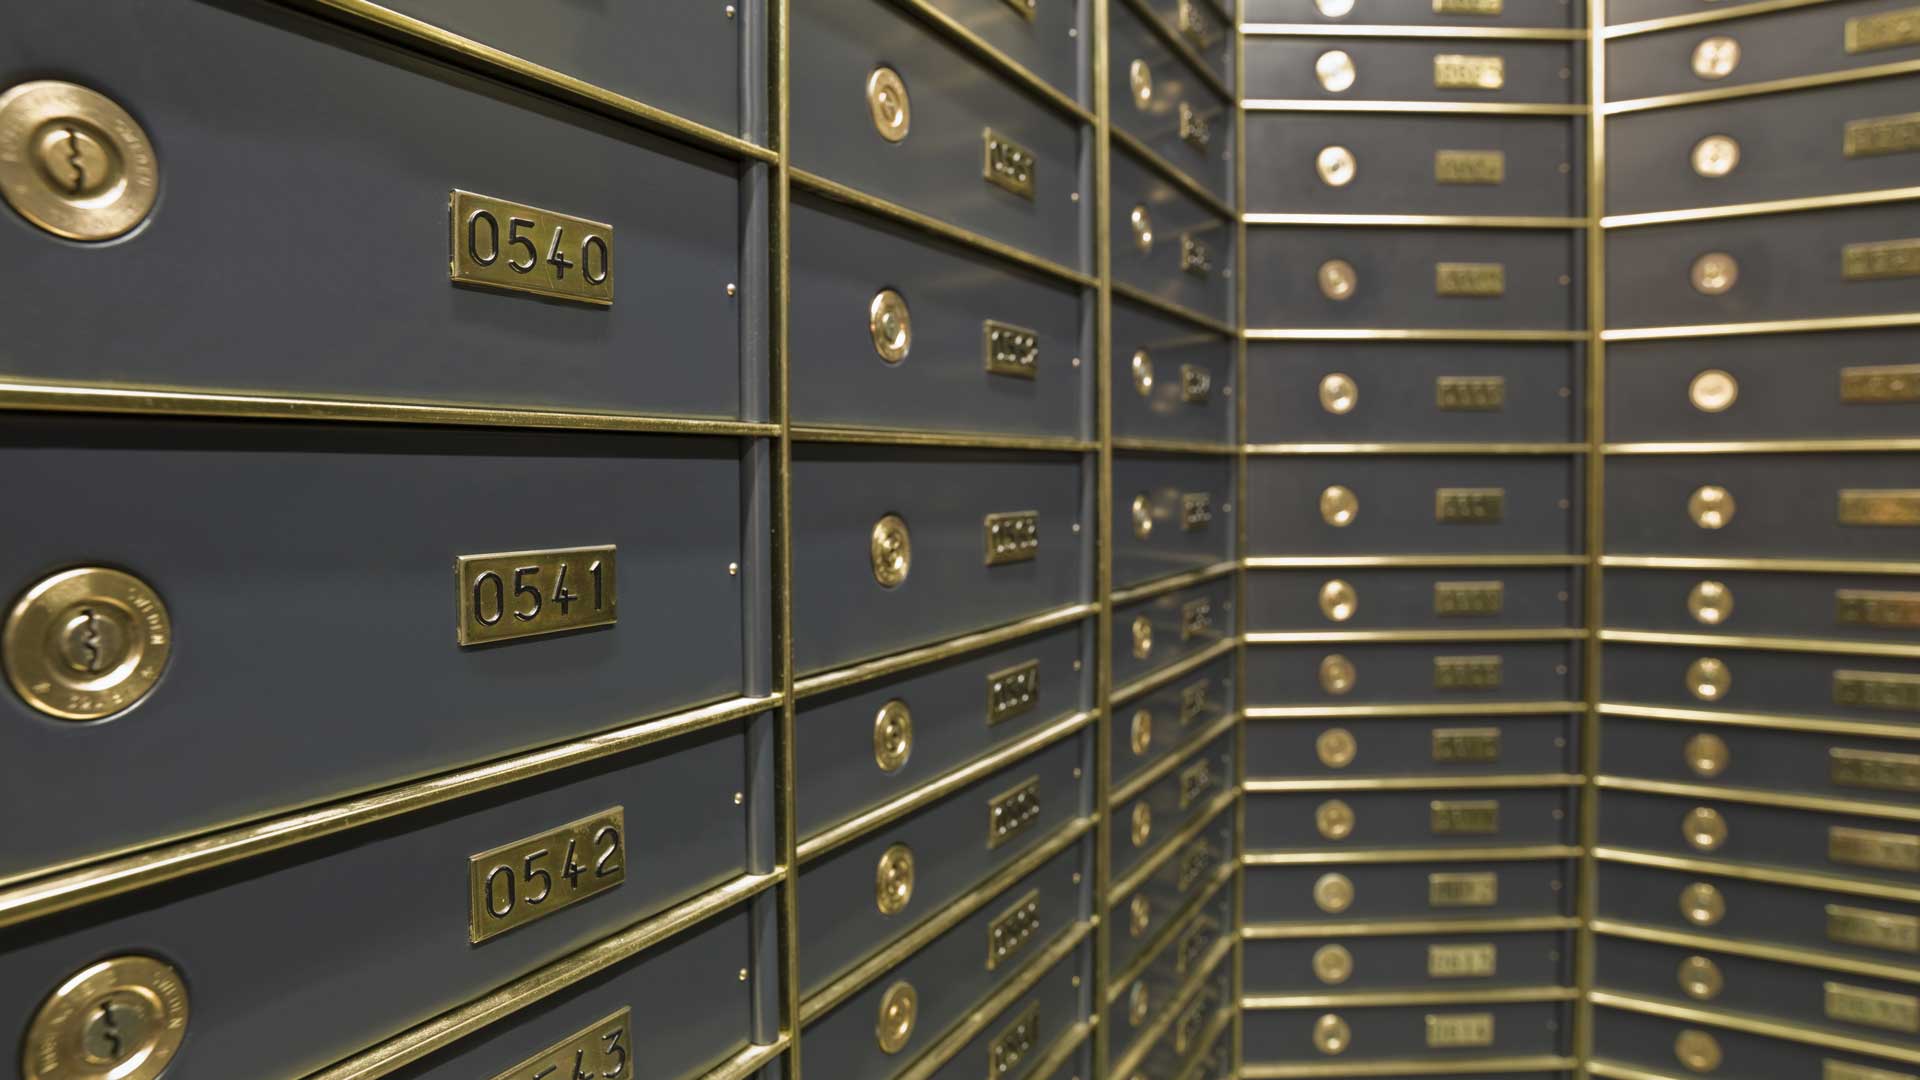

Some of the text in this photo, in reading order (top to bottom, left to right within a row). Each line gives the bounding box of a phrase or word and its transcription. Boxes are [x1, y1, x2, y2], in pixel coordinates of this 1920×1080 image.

[469, 209, 608, 285] 0540
[474, 561, 602, 625] 0541
[486, 826, 620, 917] 0542
